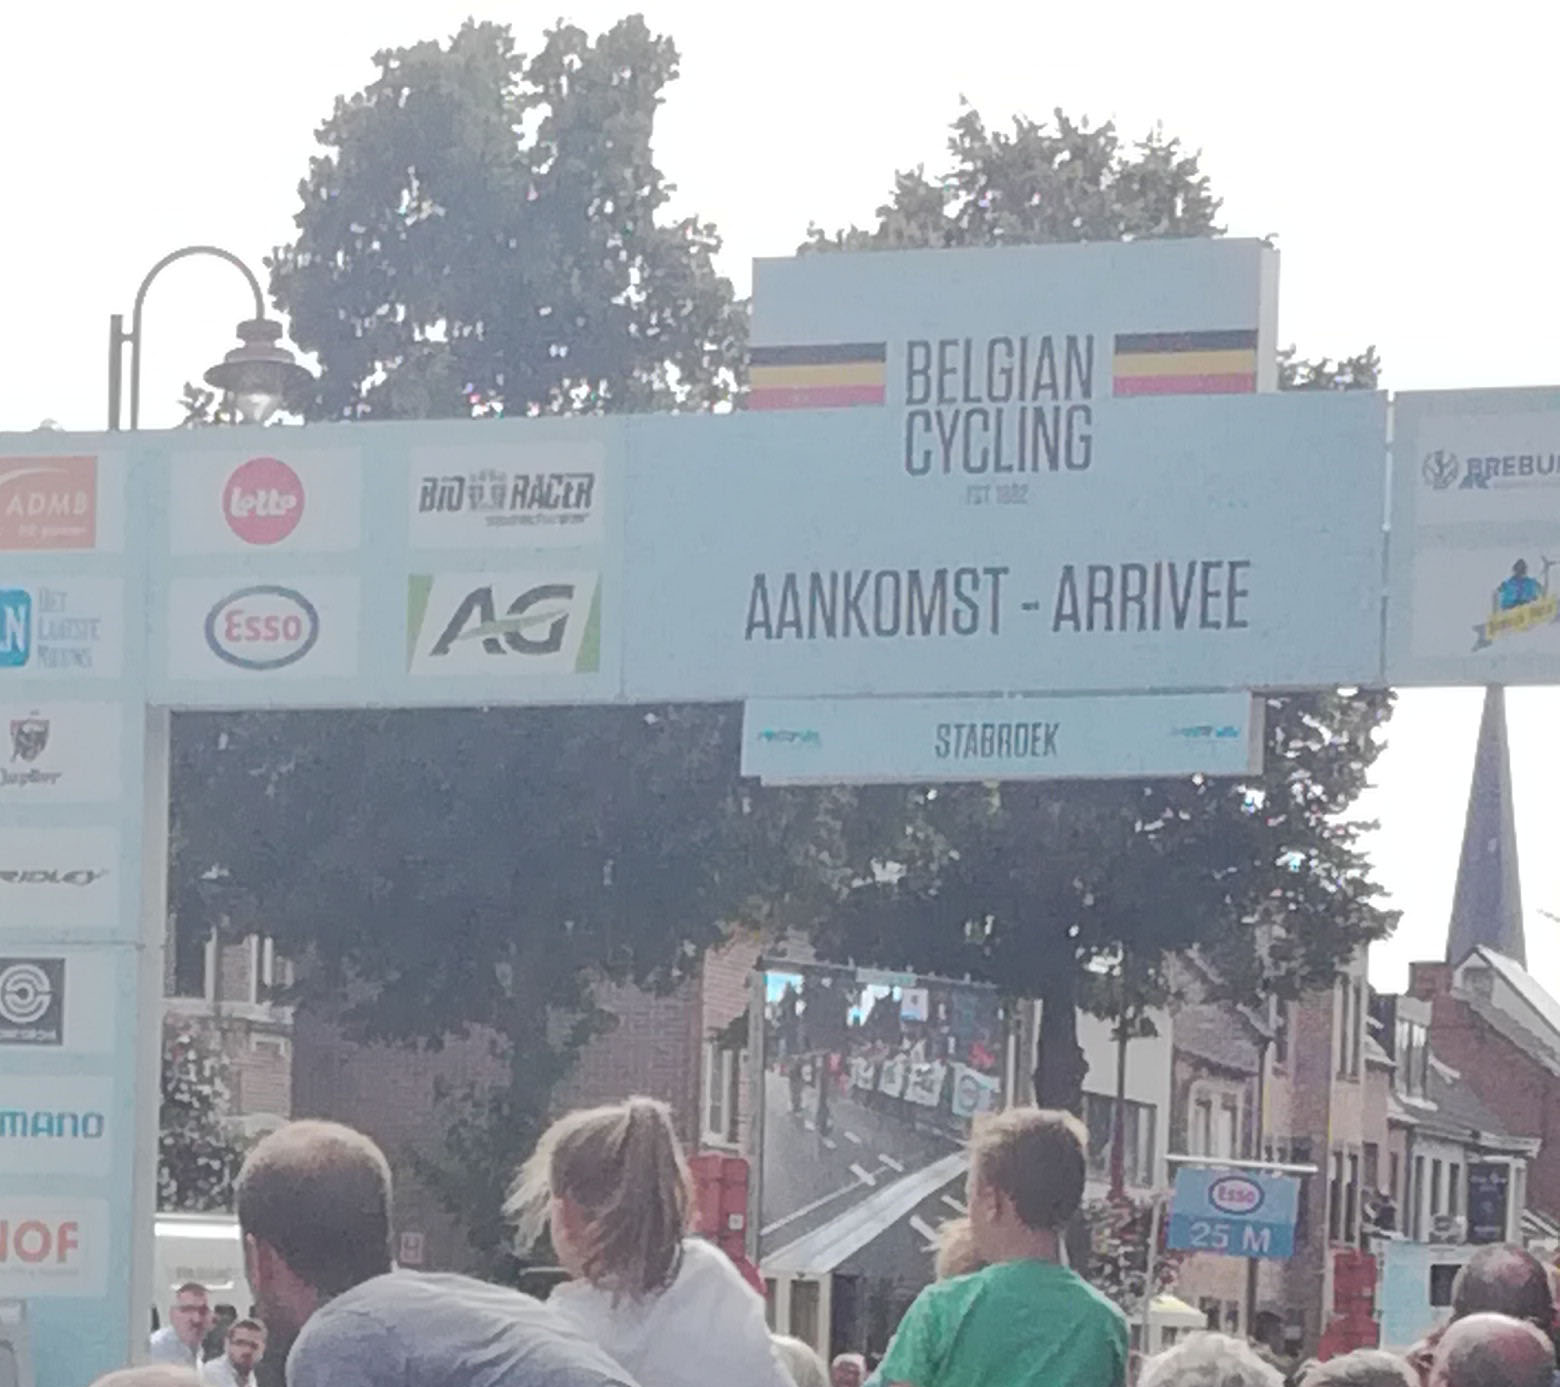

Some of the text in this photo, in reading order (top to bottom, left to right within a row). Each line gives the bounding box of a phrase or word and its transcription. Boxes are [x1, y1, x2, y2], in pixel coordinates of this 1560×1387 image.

[906, 334, 1095, 405] BELGIAN
[905, 403, 1093, 476] CYCLING
[5, 491, 89, 516] ADMB
[224, 609, 302, 643] Esso
[427, 584, 576, 656] AG
[744, 567, 1010, 641] AANKOMST
[1051, 560, 1251, 632] ARRIVEE
[934, 721, 1061, 759] STABROEK
[1191, 1221, 1271, 1253] 25 M
